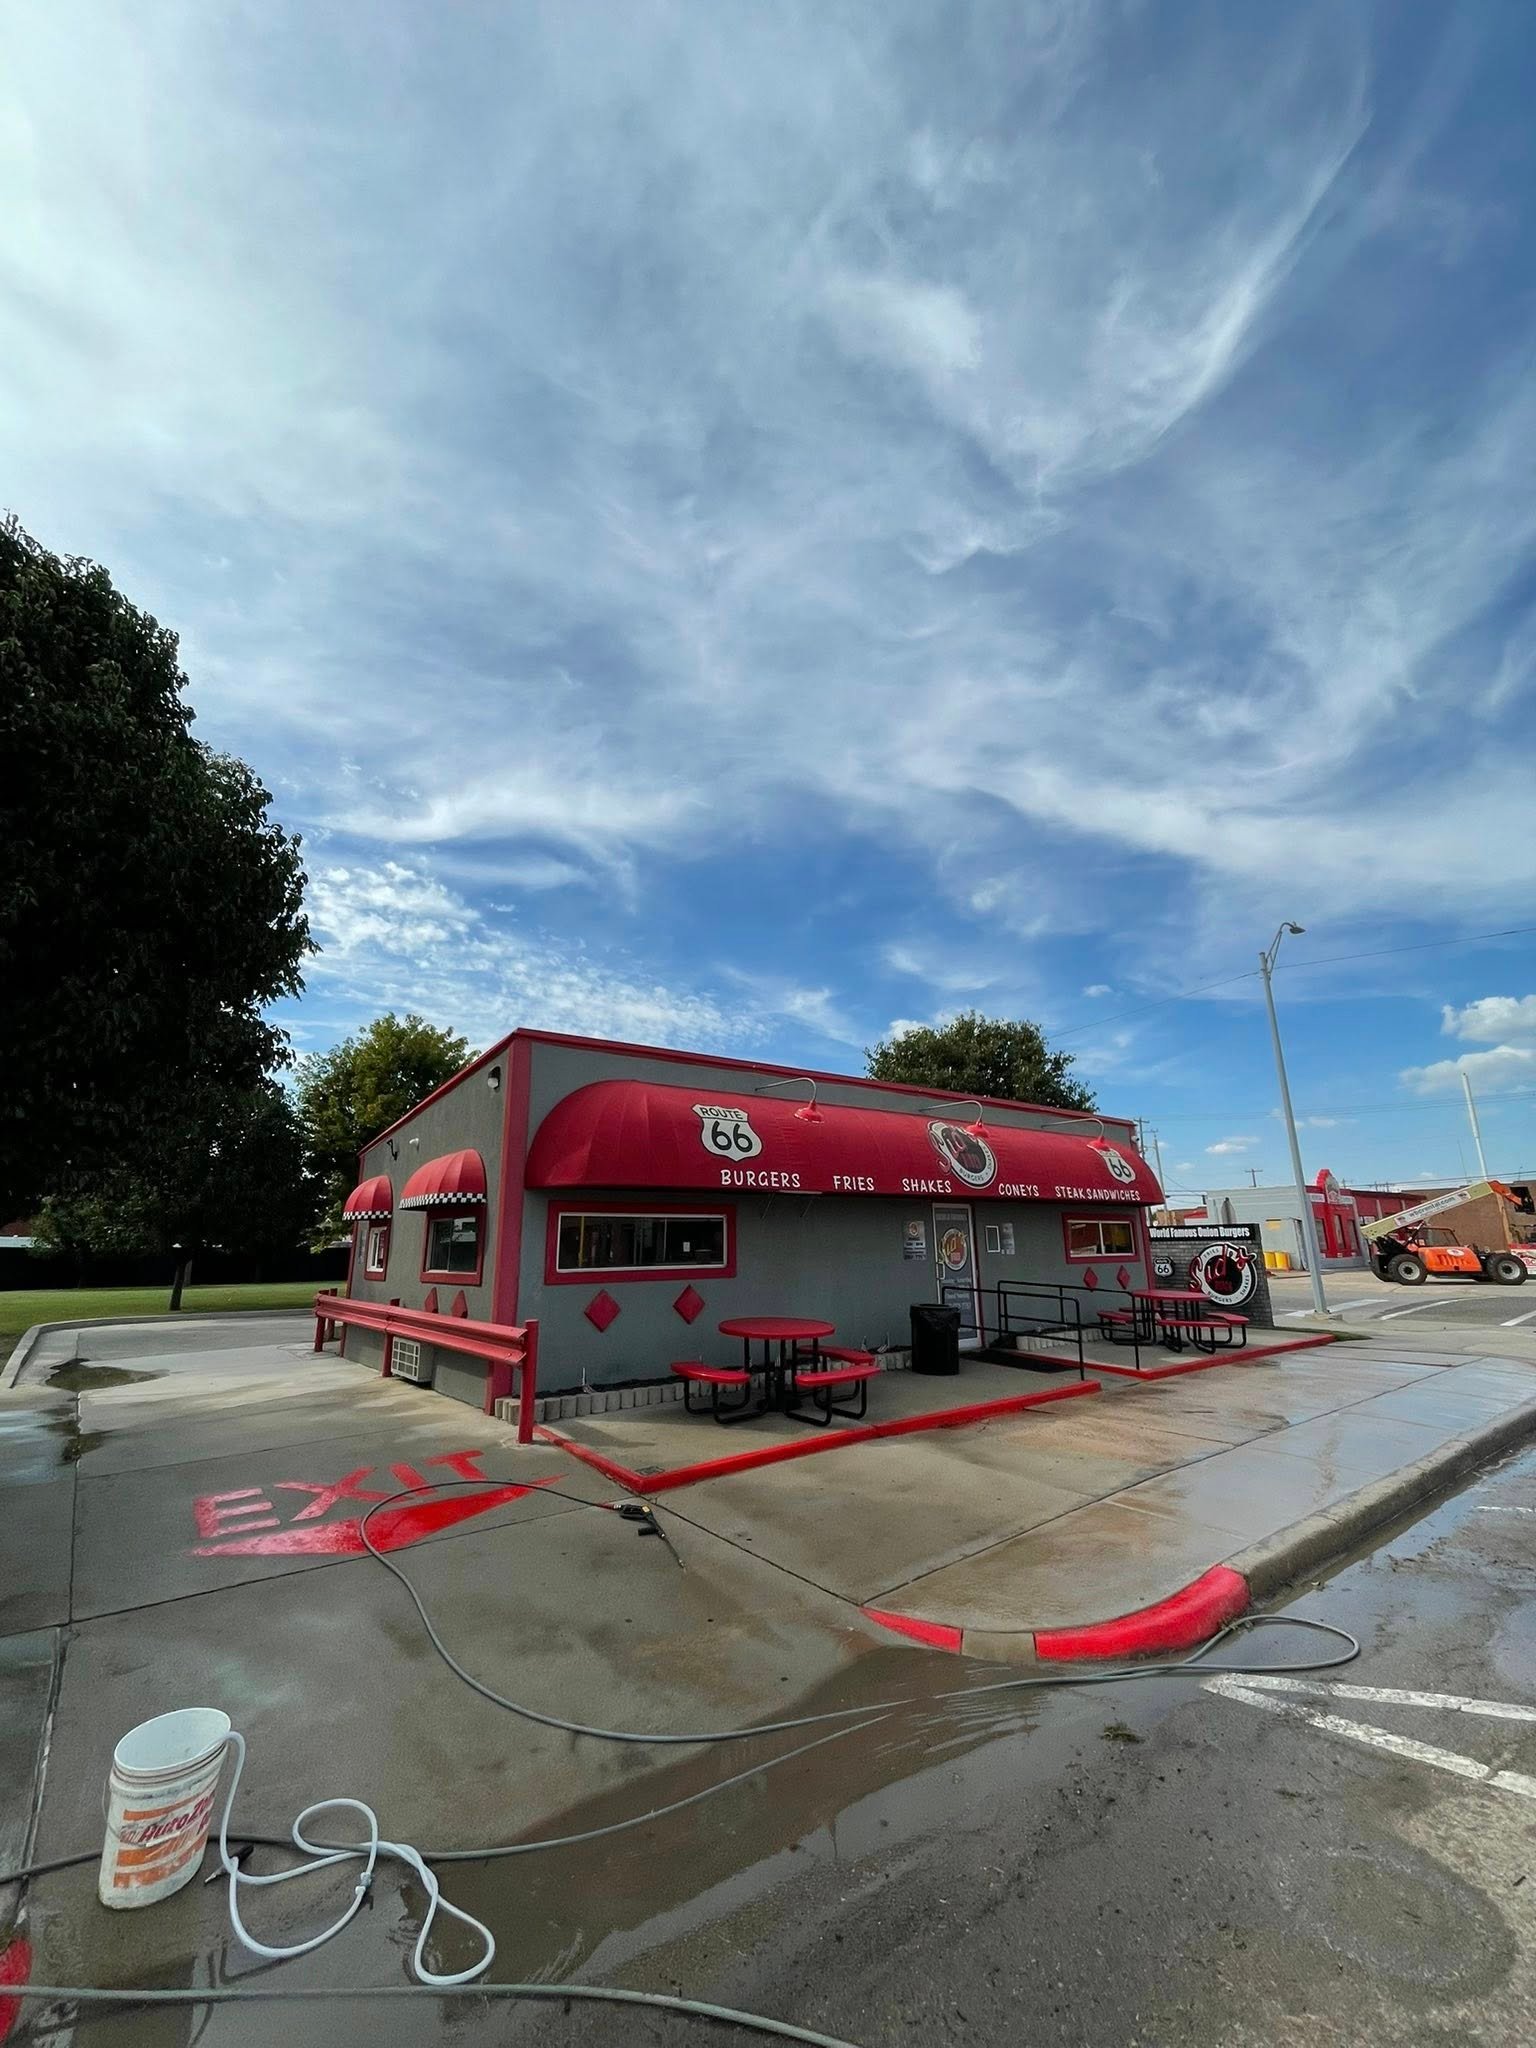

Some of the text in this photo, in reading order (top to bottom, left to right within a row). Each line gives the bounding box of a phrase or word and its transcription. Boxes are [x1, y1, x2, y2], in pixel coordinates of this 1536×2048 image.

[699, 1106, 744, 1120] ROUTE
[711, 1120, 753, 1153] 66
[1107, 1157, 1132, 1178] 66
[720, 1169, 801, 1188] BURGERS
[833, 1176, 875, 1191] FRIES
[902, 1178, 952, 1194] SHAKES
[1054, 1185, 1085, 1199] STEAK
[1086, 1188, 1141, 1201] SANDWICHES
[1148, 1226, 1250, 1239] World Famous Onion Burgers
[1157, 1264, 1170, 1274] 66
[194, 1449, 488, 1539] EXIT
